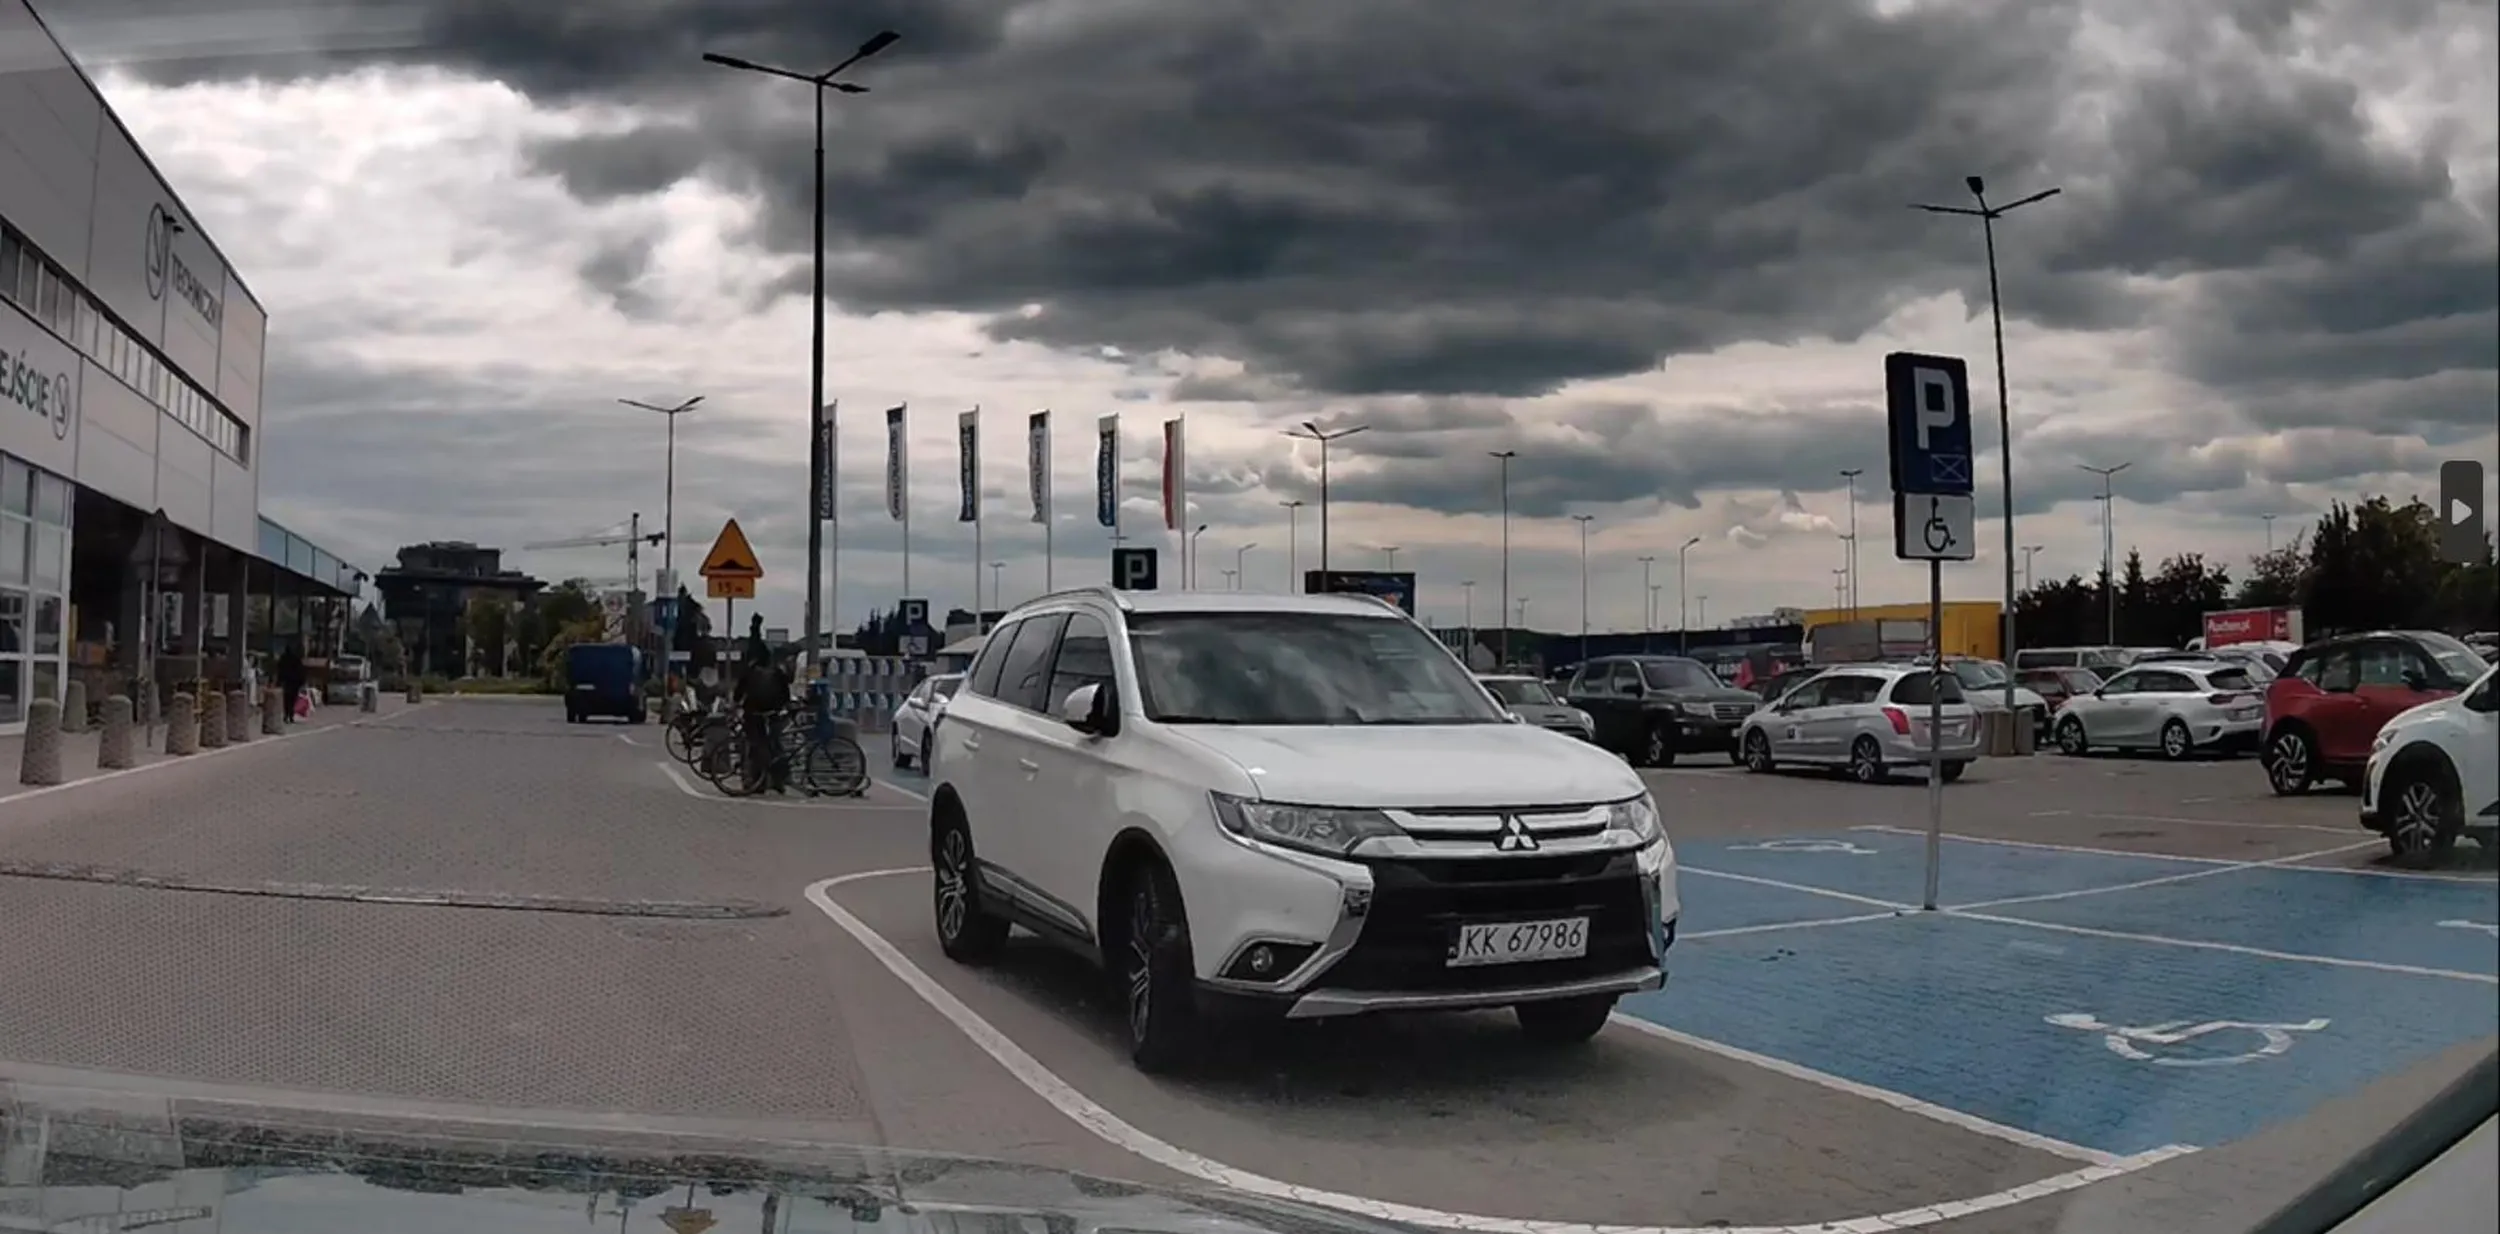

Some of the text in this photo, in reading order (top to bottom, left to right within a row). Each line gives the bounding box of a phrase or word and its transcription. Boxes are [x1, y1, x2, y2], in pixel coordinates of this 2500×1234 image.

[1913, 366, 1955, 450] P
[1124, 553, 1148, 589] P
[906, 603, 924, 626] P
[1465, 919, 1583, 956] KK 67986
